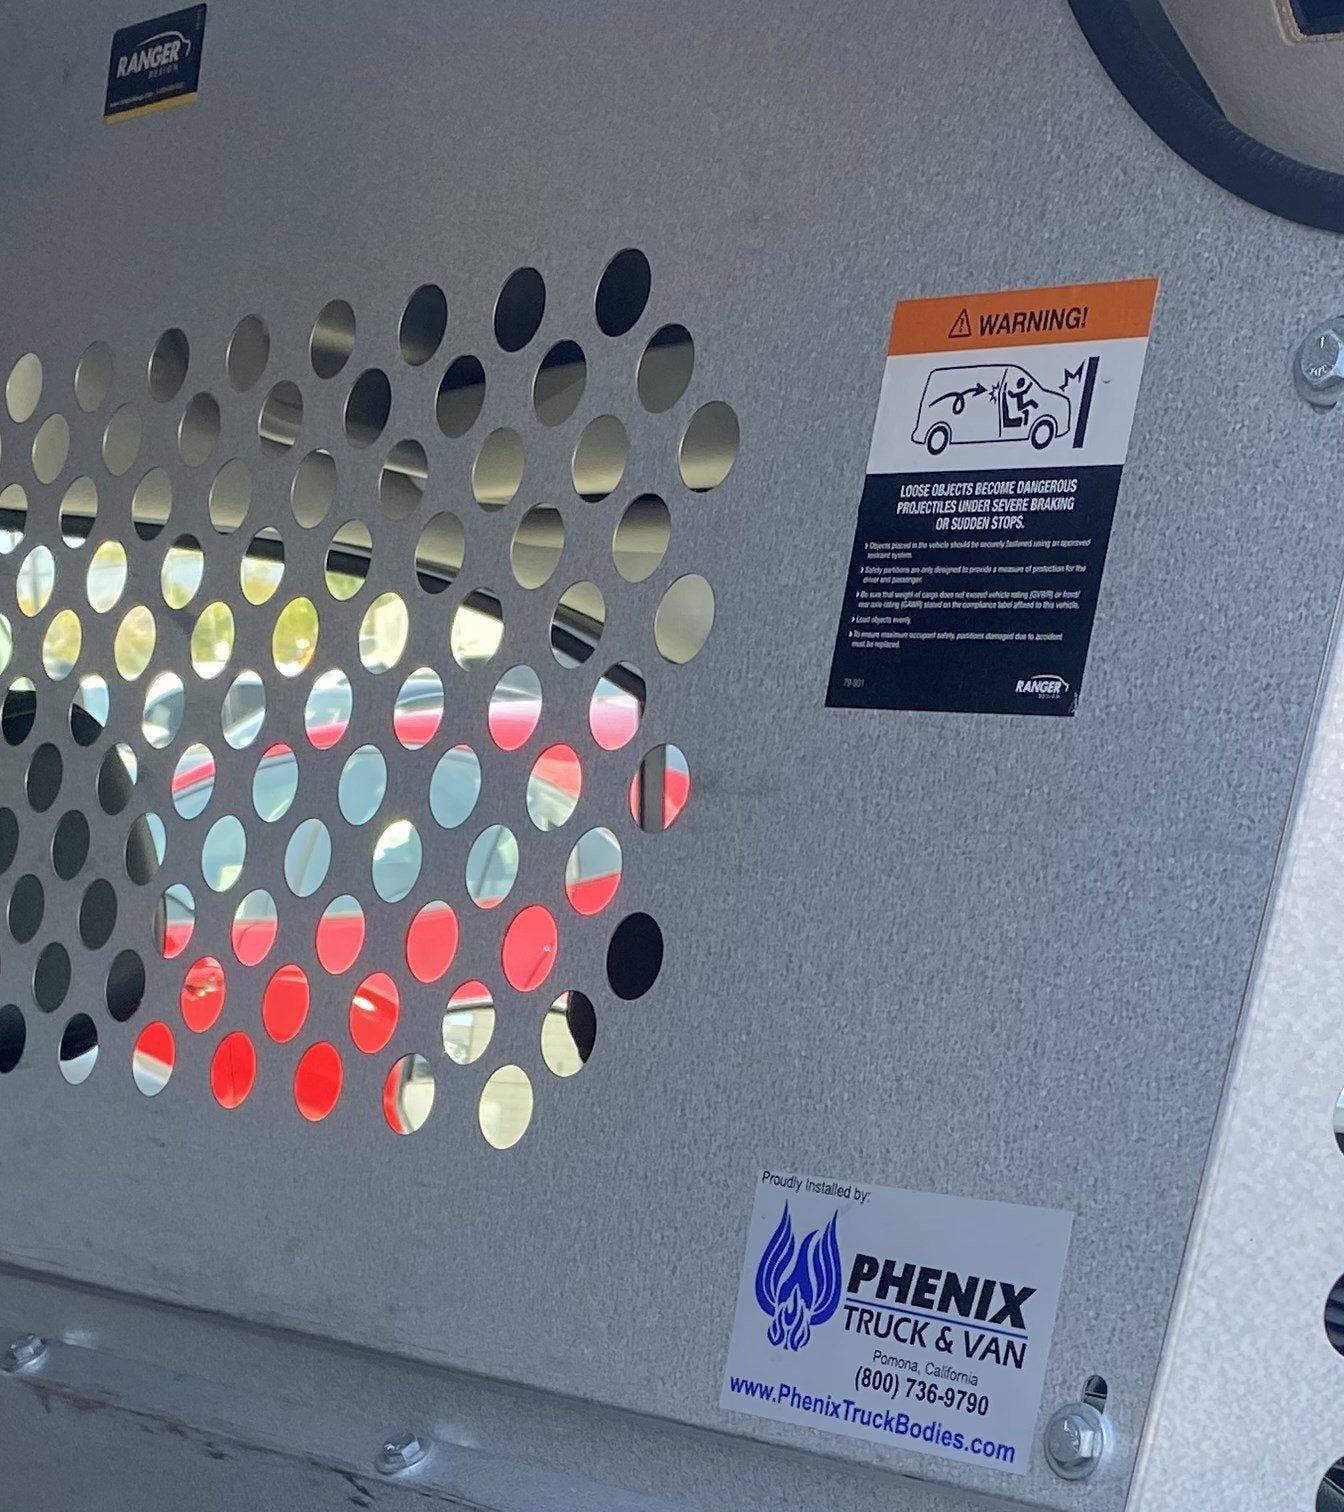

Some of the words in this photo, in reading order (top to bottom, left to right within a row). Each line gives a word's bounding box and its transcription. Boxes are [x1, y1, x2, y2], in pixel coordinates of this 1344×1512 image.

[117, 41, 180, 79] RANGER
[980, 305, 1089, 336] WARNING!
[900, 484, 930, 498] LOOSE
[932, 482, 973, 496] OBJECTS
[975, 481, 1015, 494] BECOME
[1017, 479, 1077, 493] DANGEROUS
[897, 500, 956, 514] PROJECTILES
[958, 500, 990, 512] UNDER
[992, 499, 1028, 511] SEVERE
[1030, 497, 1074, 511] BRAKING
[936, 518, 949, 530] OR
[951, 516, 989, 530] SUDDEN
[991, 516, 1024, 529] STOPS.
[980, 540, 1005, 549] securely
[1033, 540, 1051, 548] using
[1061, 539, 1091, 547] approved
[865, 566, 882, 574] Safety
[934, 566, 961, 574] designed
[1032, 565, 1064, 573] protection
[922, 591, 938, 599] cargo
[1011, 591, 1029, 599] rating
[962, 601, 996, 609] compliance
[871, 616, 891, 624] objects
[909, 632, 936, 640] occupant
[957, 633, 984, 641] partitions
[985, 633, 1014, 641] damaged
[1035, 633, 1063, 641] accident
[1016, 679, 1062, 694] RANGER
[762, 1171, 802, 1192] Proudly
[854, 1187, 871, 1204] by:
[846, 1254, 1037, 1330] PHENIX
[844, 1305, 930, 1349] TRUCK
[935, 1327, 953, 1353] &
[964, 1331, 1028, 1369] VAN
[873, 1350, 920, 1374] Pomona,
[925, 1362, 978, 1386] California
[854, 1366, 900, 1400] (800)
[906, 1378, 989, 1416] 736-9790
[730, 1376, 1015, 1463] www.PhenixTruckBodies.com
